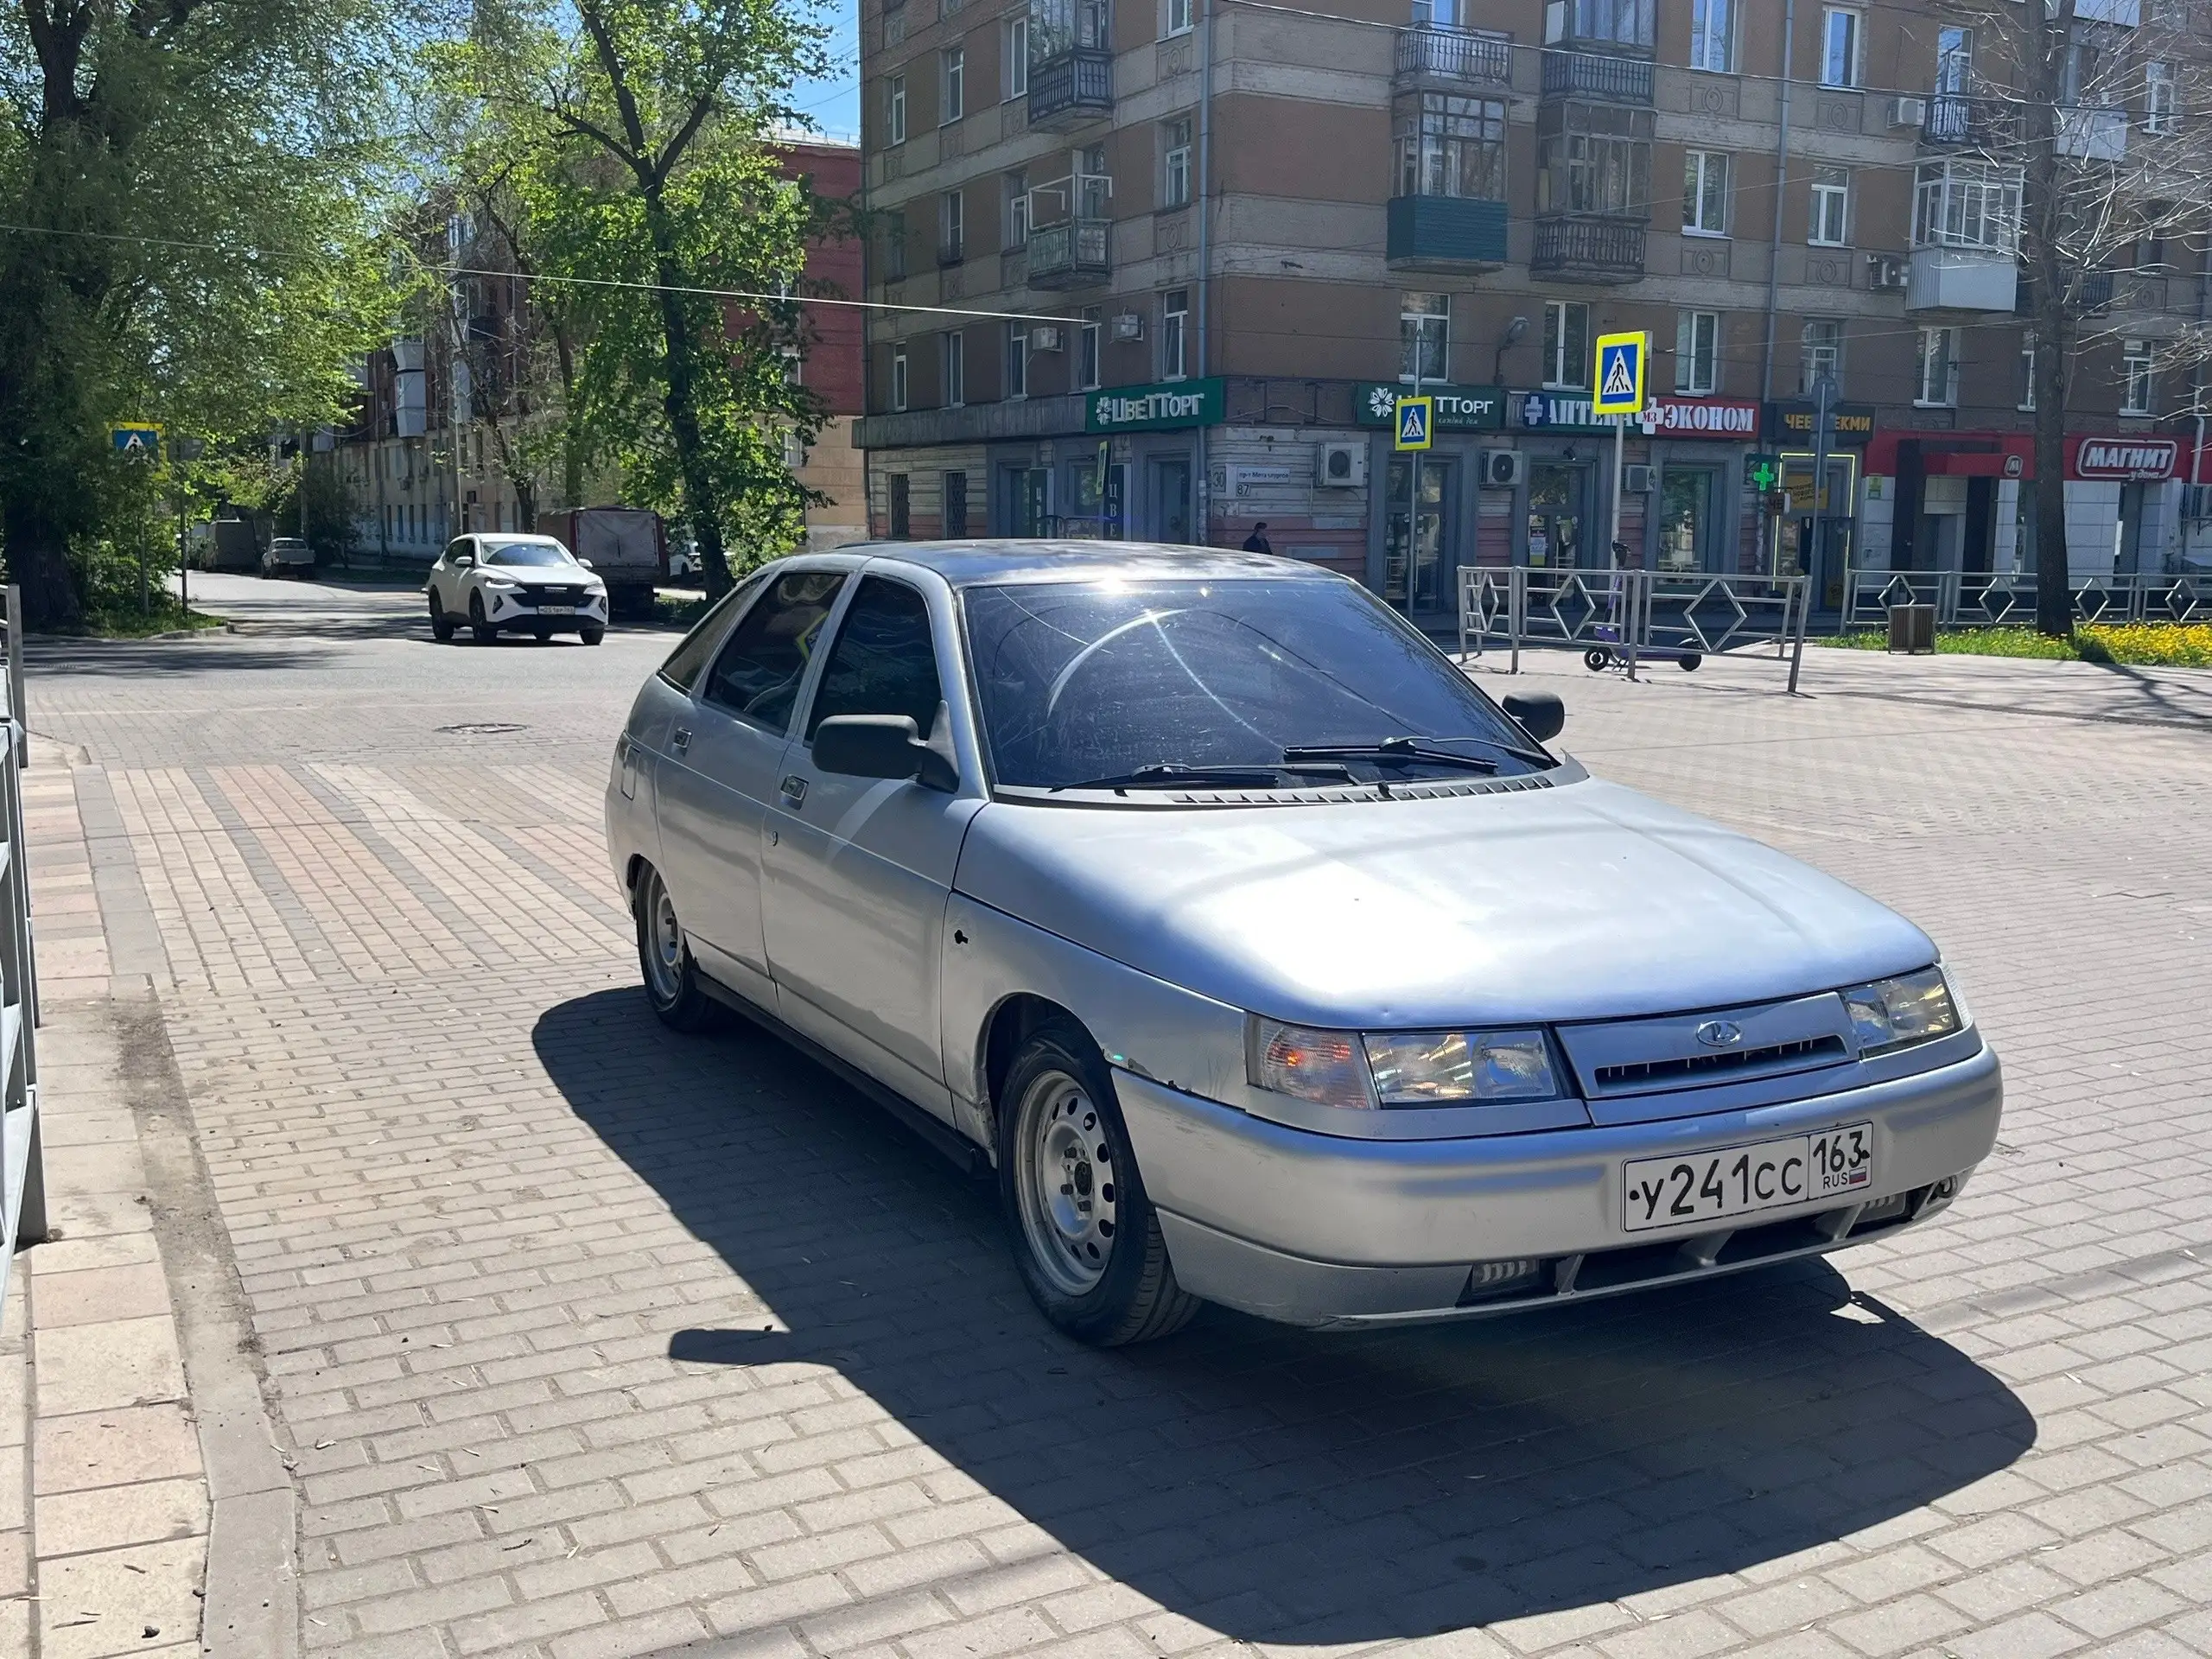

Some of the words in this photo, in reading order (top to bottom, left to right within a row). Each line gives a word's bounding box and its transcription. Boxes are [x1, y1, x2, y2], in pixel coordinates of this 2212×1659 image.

[1664, 404, 1754, 432] ЭКОНОМ
[1784, 414, 1871, 431] ЧЕБЕКМИ
[2086, 447, 2171, 469] МАГНИТ
[1236, 484, 1249, 495] 87
[1641, 1154, 1802, 1220] У241СС
[1812, 1130, 1864, 1175] 163
[1822, 1172, 1848, 1190] RUS
